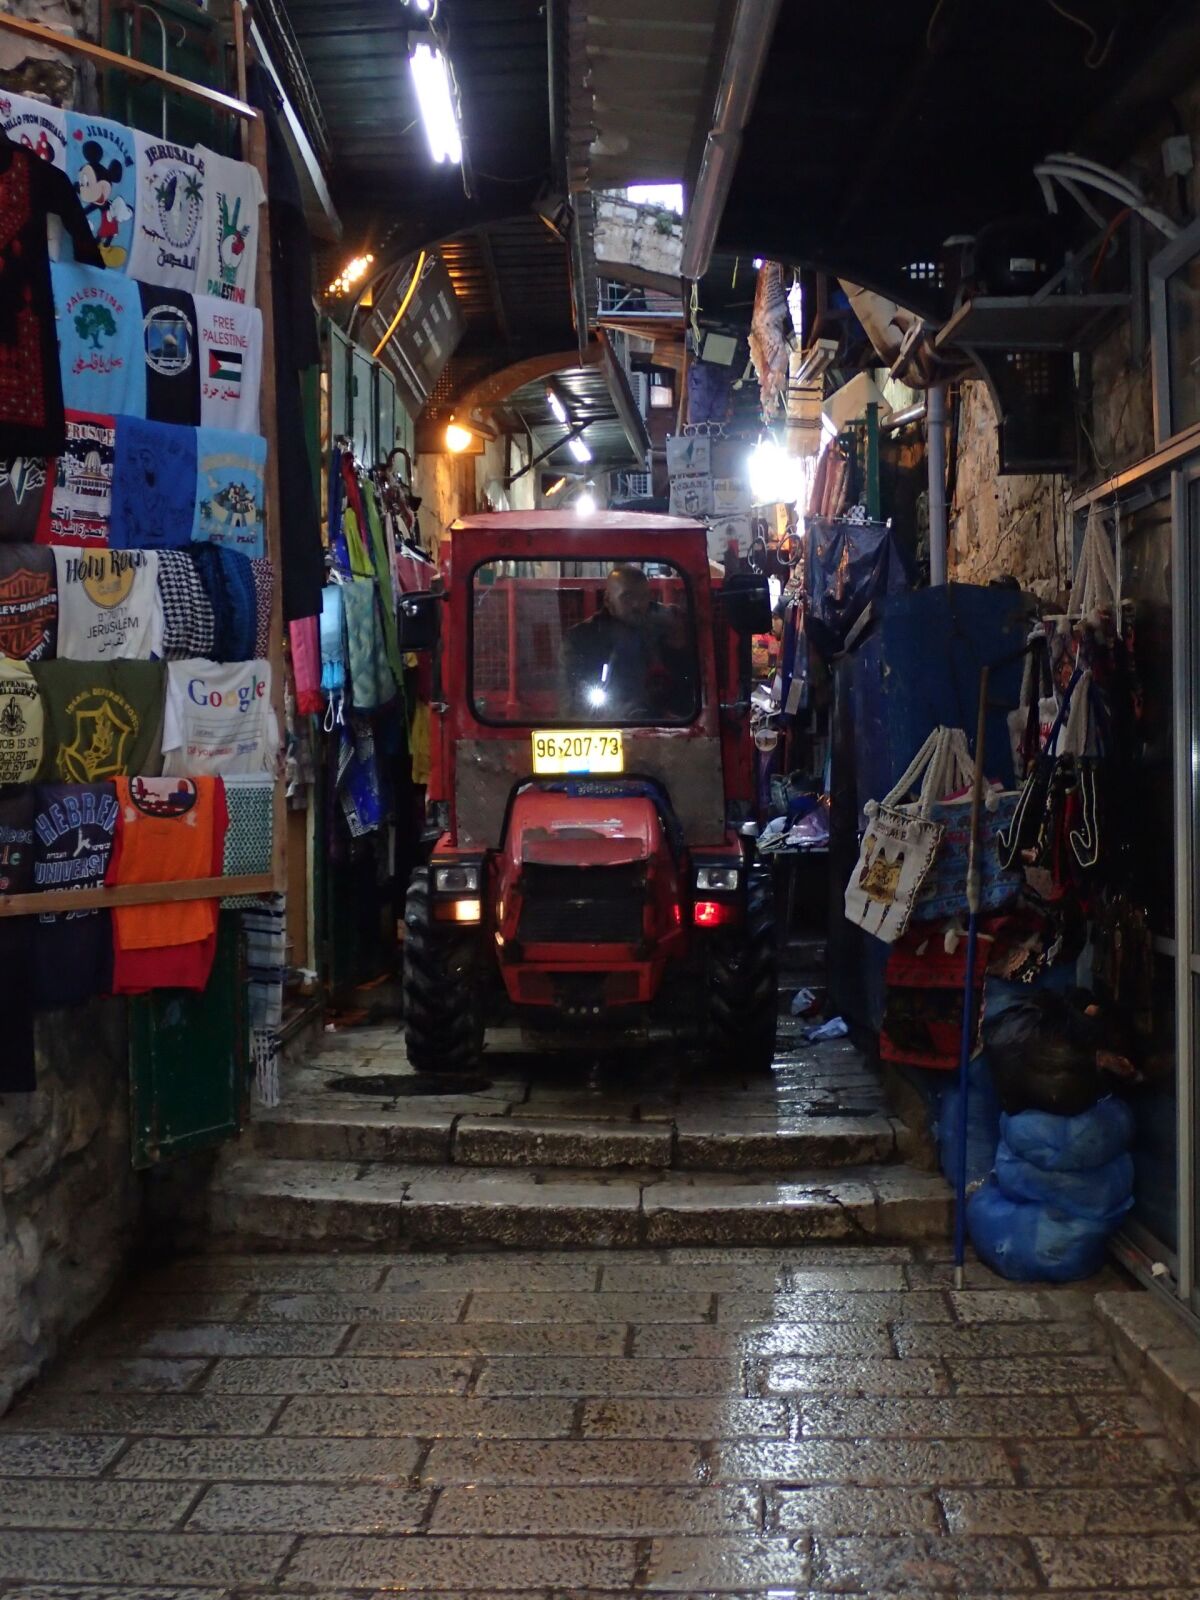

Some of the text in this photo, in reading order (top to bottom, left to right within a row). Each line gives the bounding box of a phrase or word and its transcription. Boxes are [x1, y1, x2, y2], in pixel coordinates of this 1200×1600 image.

[22, 114, 39, 124] FROM
[144, 144, 205, 177] JERUSALE
[65, 288, 124, 314] PALESTINE
[213, 315, 235, 331] FREE
[203, 328, 248, 348] PALESTINE
[66, 555, 105, 584] Holy
[188, 675, 265, 713] Google
